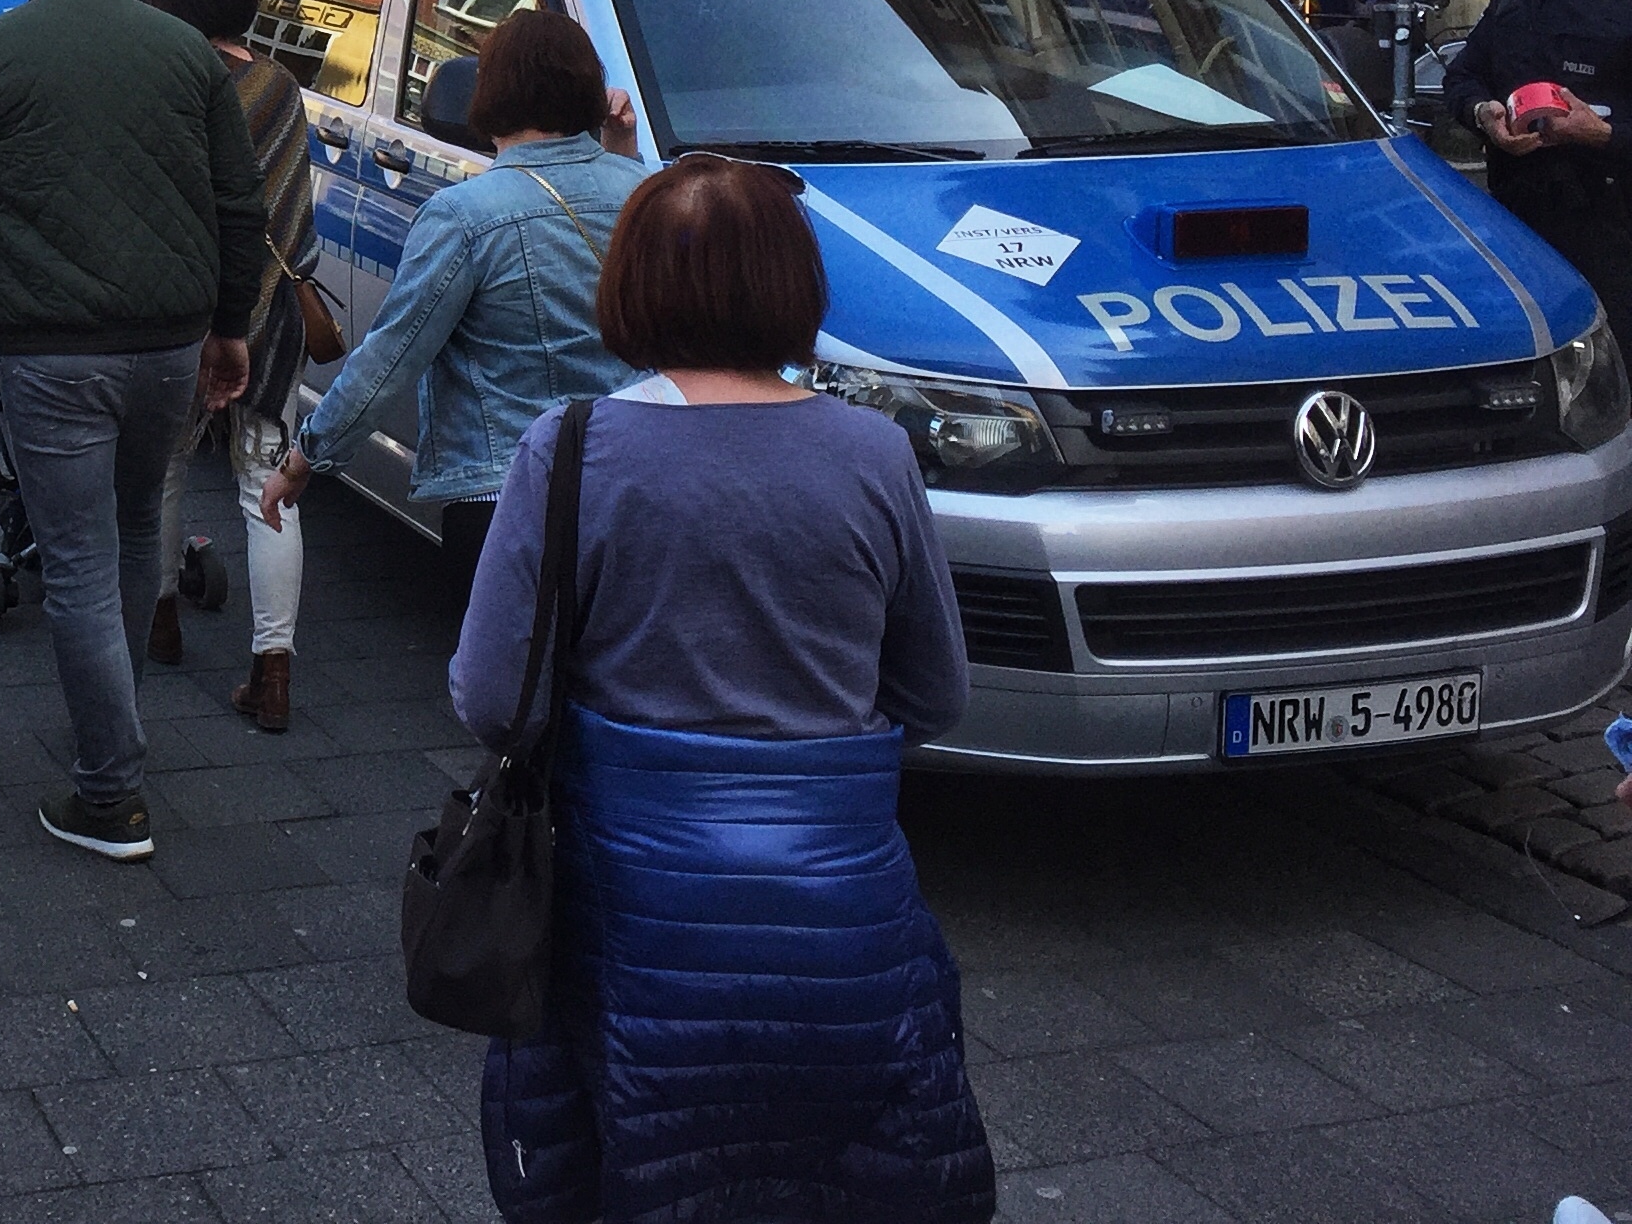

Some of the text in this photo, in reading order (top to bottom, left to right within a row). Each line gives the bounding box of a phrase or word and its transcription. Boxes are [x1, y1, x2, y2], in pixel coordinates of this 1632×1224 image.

[1563, 60, 1595, 75] POLIZEI
[997, 241, 1024, 254] 17
[995, 255, 1055, 269] NRW
[1076, 274, 1480, 353] POLIZEI
[1252, 696, 1325, 746] NRW
[1351, 681, 1477, 738] 5-4980
